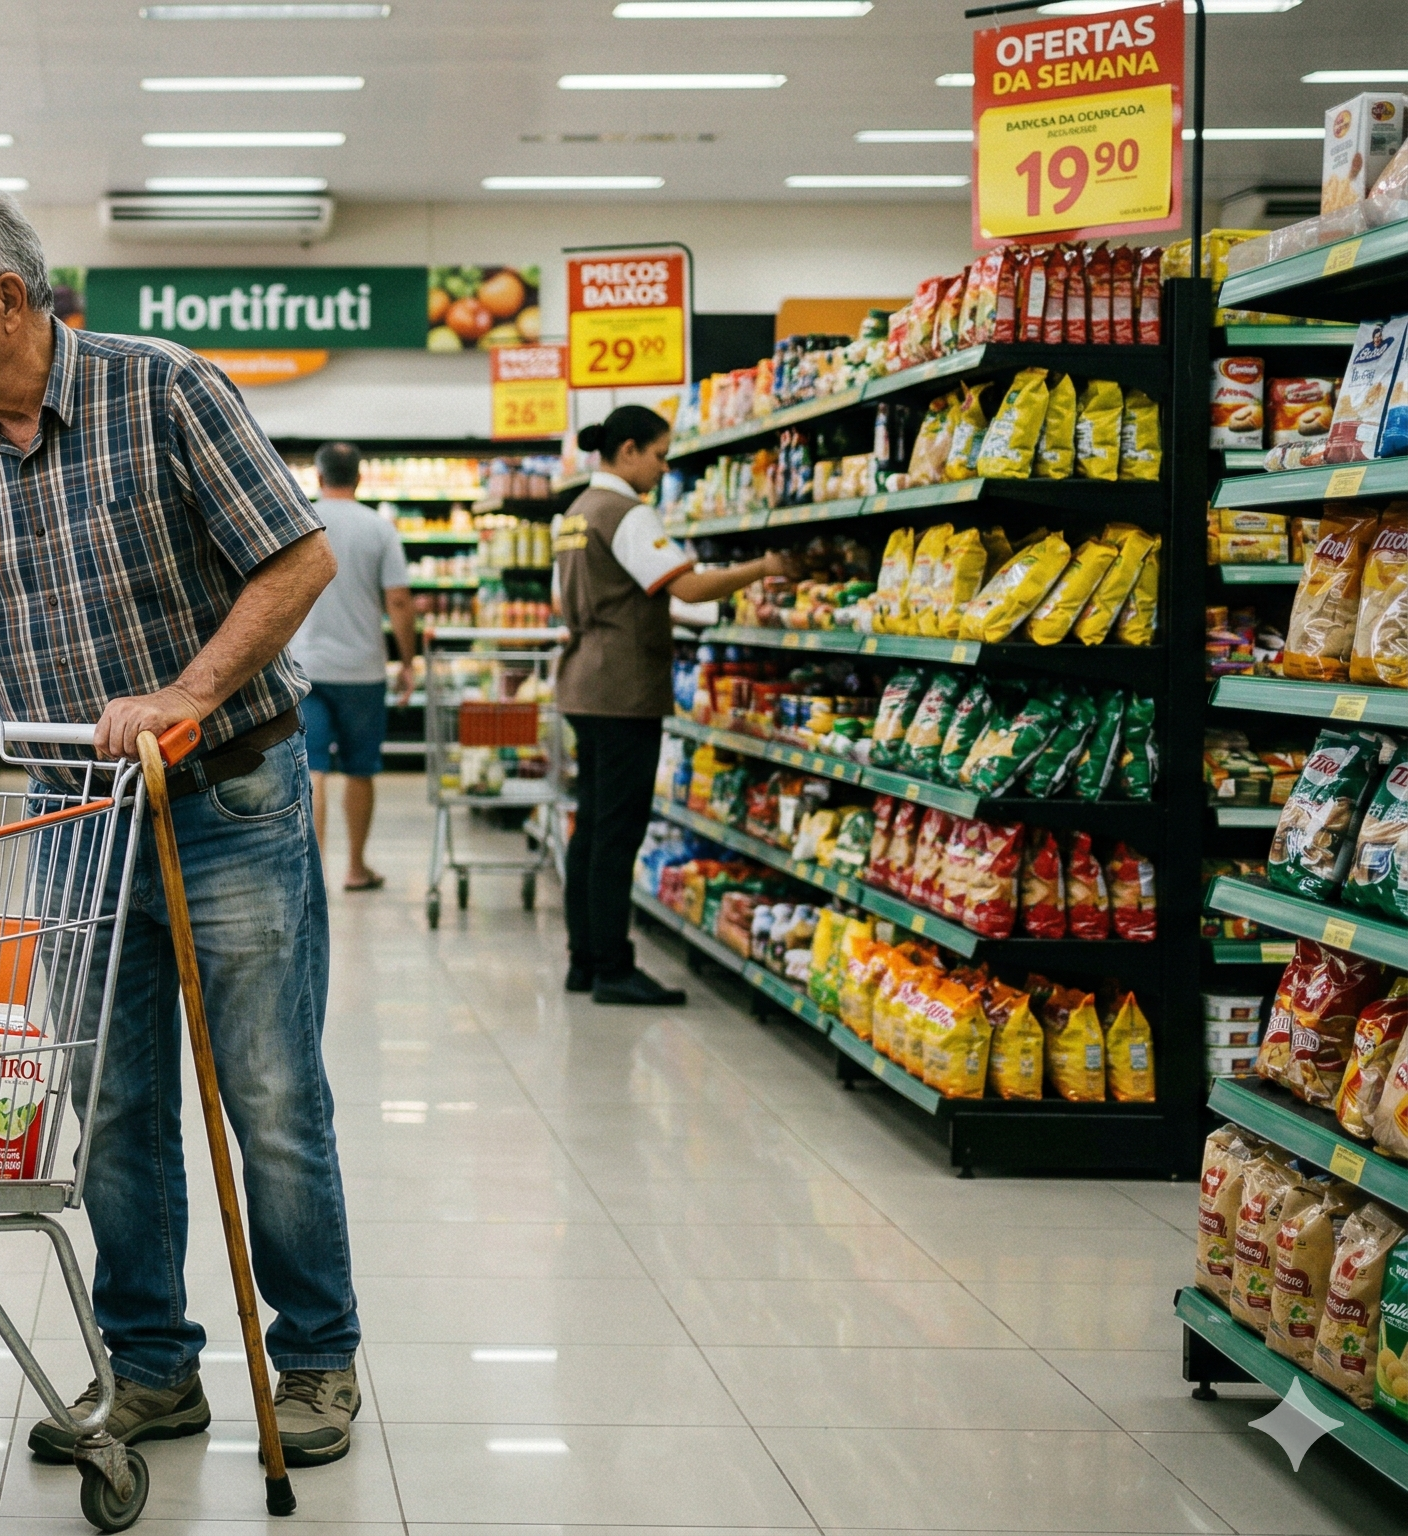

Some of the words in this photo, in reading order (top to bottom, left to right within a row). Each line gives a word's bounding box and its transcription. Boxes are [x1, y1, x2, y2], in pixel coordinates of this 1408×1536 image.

[996, 15, 1156, 67] OFERTAS
[993, 69, 1032, 95] DA
[1037, 51, 1159, 89] SEMANA
[1016, 145, 1089, 217] 19
[1094, 138, 1139, 176] 90
[581, 262, 668, 286] PREÇOS
[583, 285, 667, 307] BAIXOS
[139, 283, 372, 331] Hortifruti
[588, 337, 635, 373] 29
